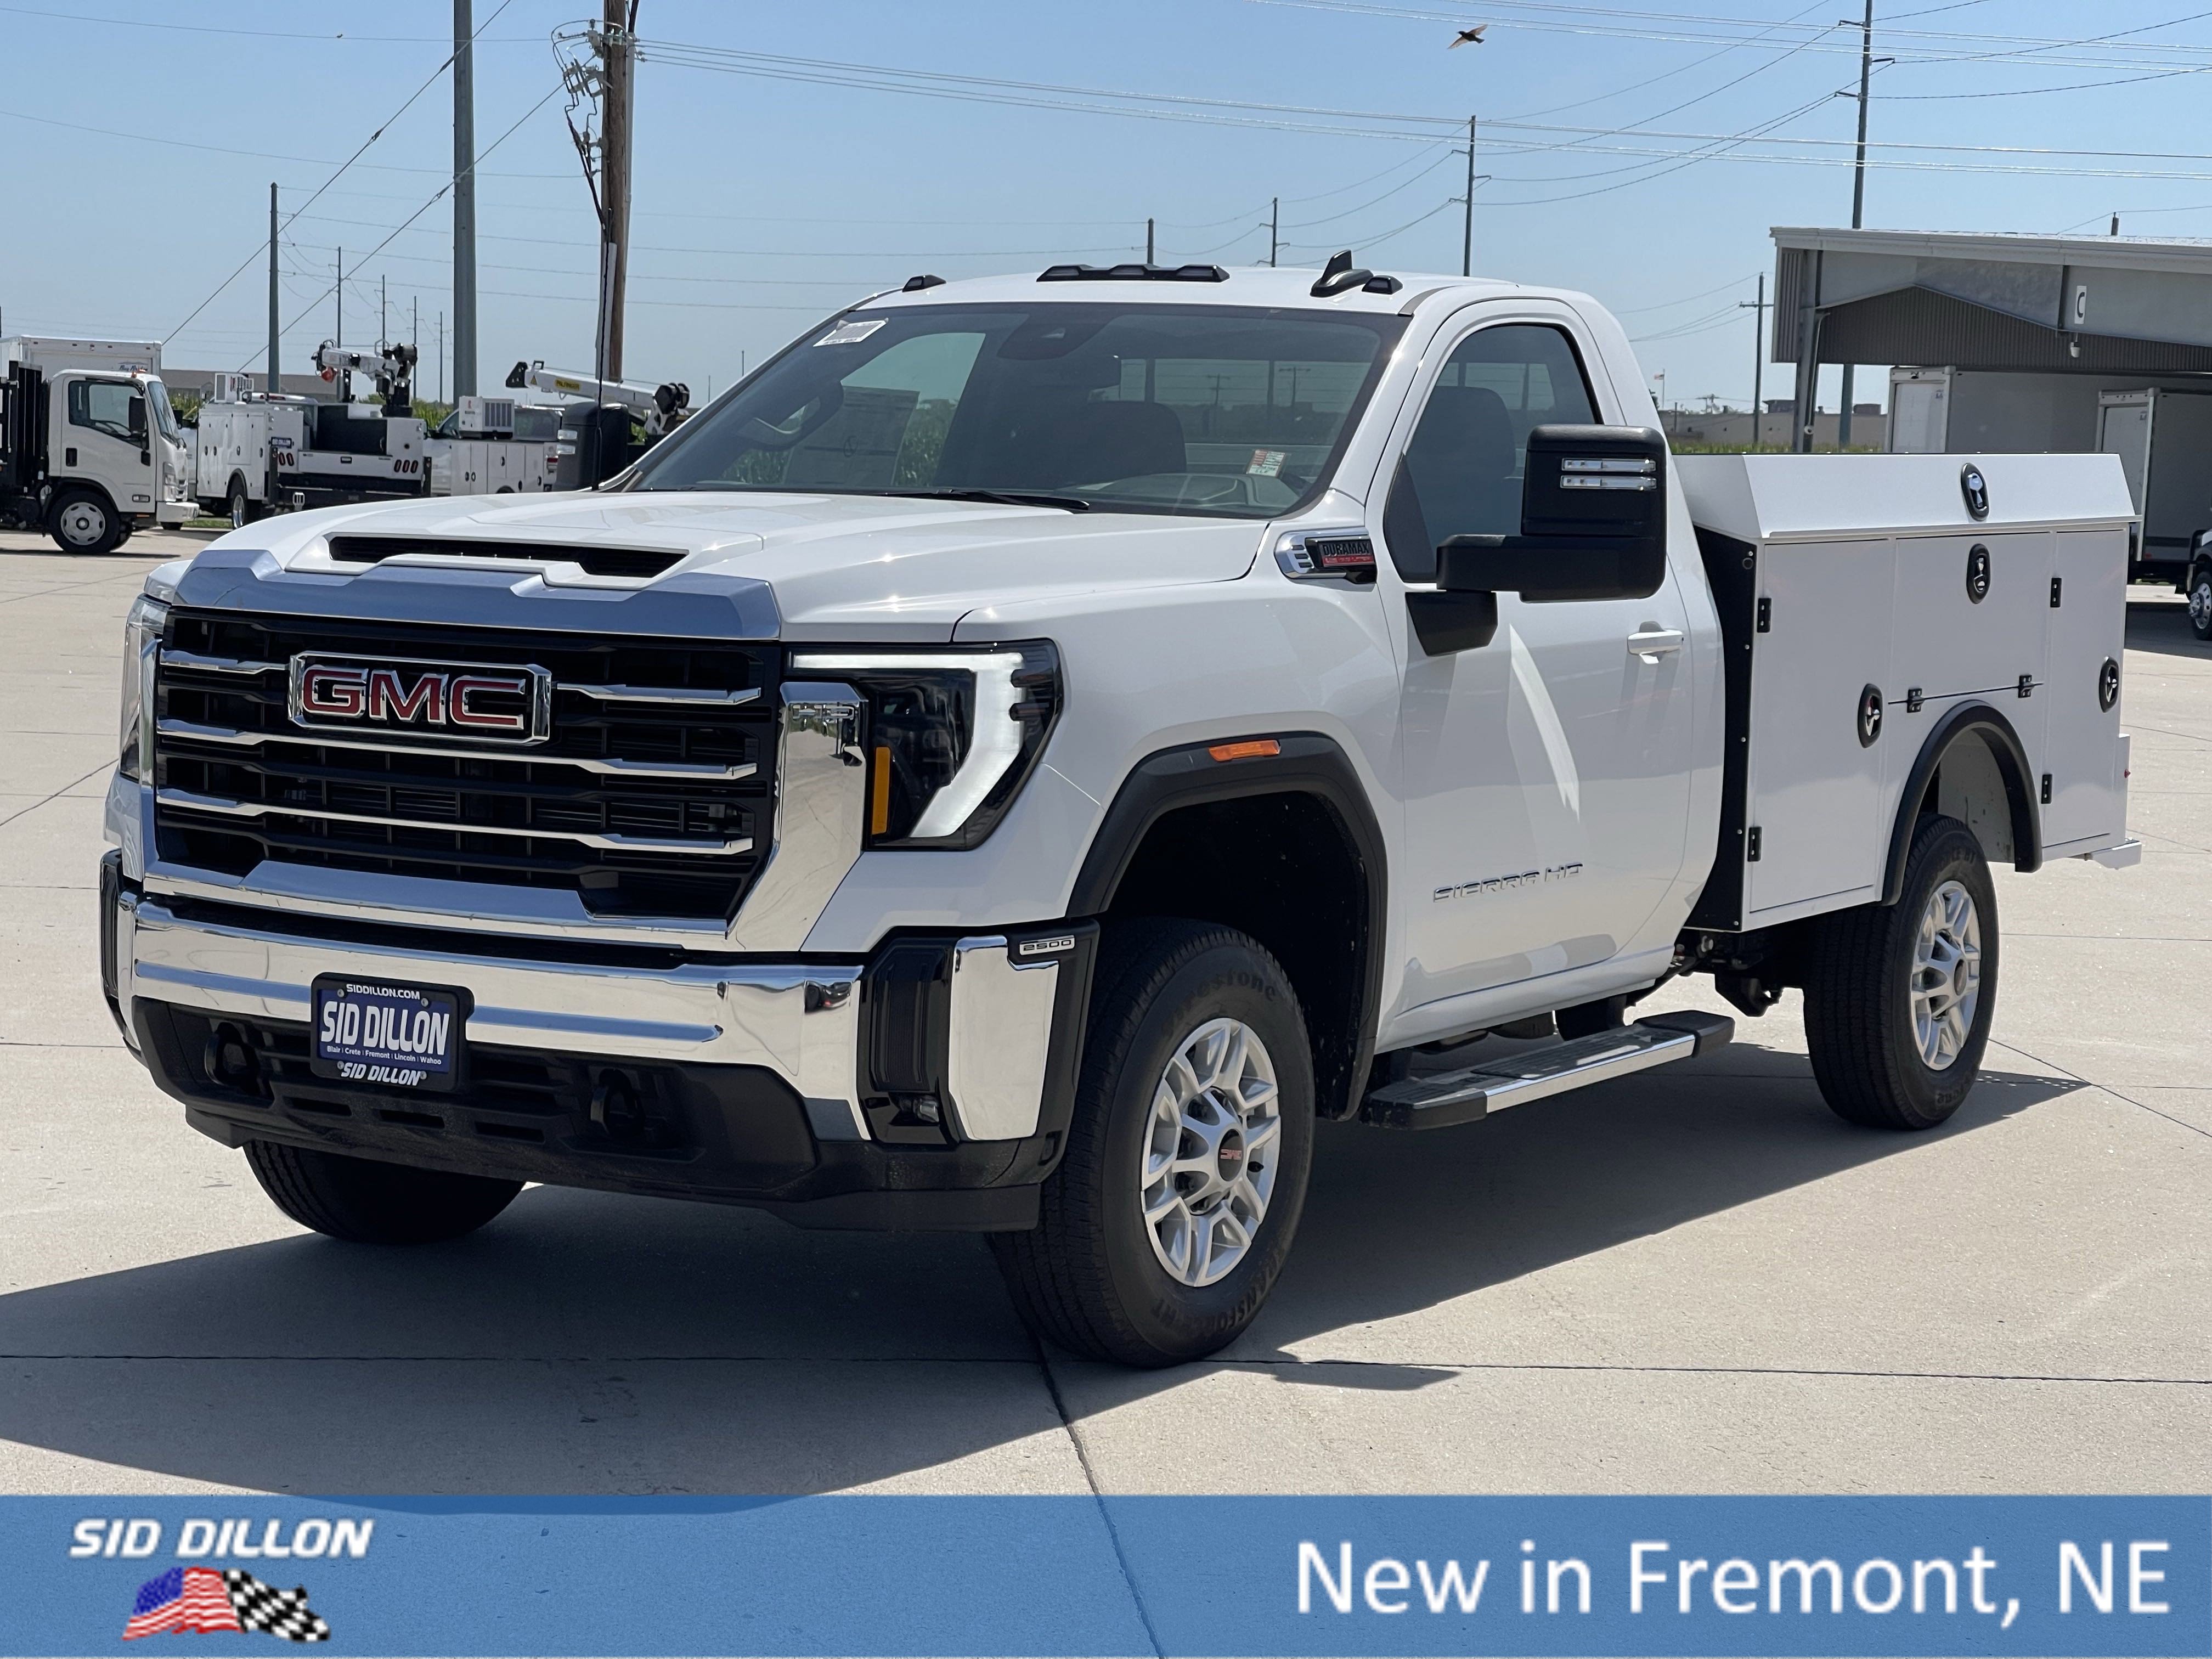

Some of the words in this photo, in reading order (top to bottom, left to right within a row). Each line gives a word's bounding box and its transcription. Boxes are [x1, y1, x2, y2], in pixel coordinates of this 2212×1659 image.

[2076, 291, 2085, 318] C
[1322, 542, 1370, 556] DURAMAX
[302, 664, 526, 730] GMC
[1433, 871, 1540, 903] SIERRA
[1544, 862, 1583, 882] HD
[1023, 940, 1071, 951] 2500
[346, 983, 420, 1000] SIDDILLON.COM
[321, 1001, 360, 1045] SID
[363, 1005, 450, 1056] DILLON
[327, 1045, 341, 1053] Blair
[345, 1047, 361, 1056] Crete
[365, 1049, 390, 1059] Fremont
[394, 1053, 416, 1062] Lincoln
[420, 1056, 442, 1065] Wahoo
[341, 1062, 366, 1079] SID
[367, 1065, 421, 1086] DILLON
